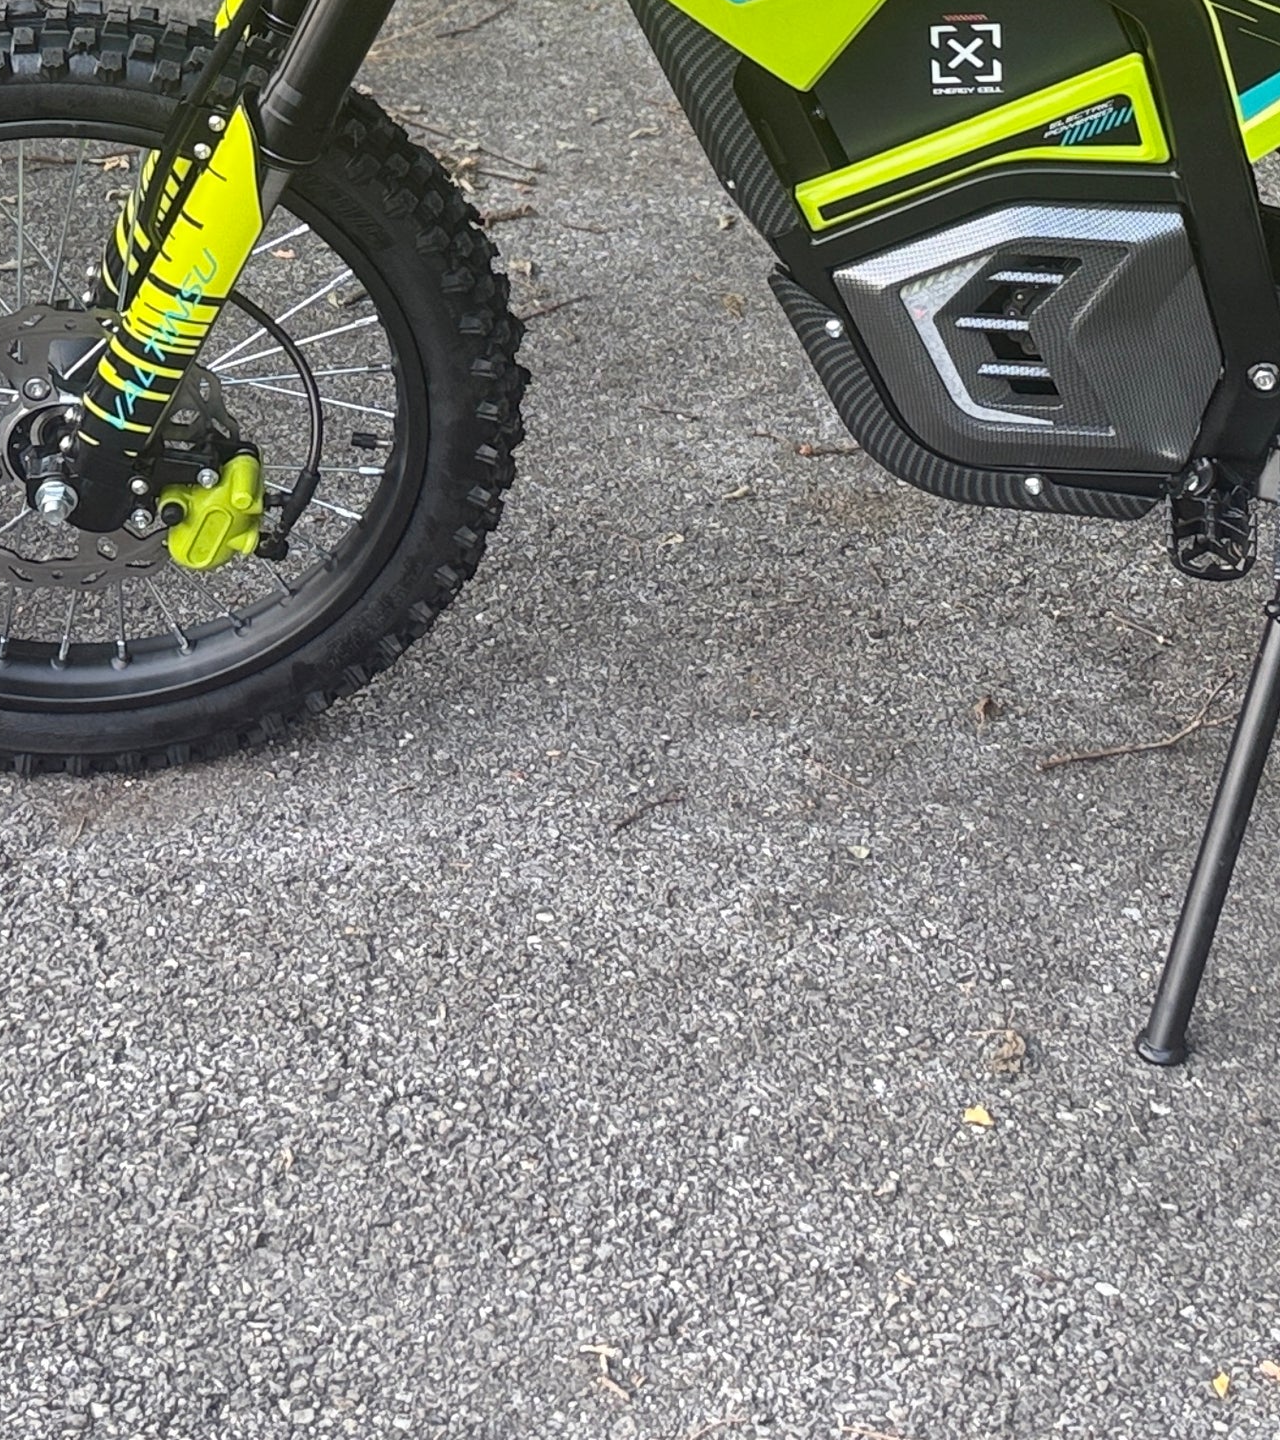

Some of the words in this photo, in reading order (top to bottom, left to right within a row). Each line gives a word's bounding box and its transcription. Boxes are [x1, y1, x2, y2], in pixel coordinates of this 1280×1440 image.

[931, 86, 976, 96] ENERGY
[976, 85, 1005, 95] CELL
[1043, 107, 1114, 139] POWERED
[1048, 98, 1116, 130] ELECTRIC
[104, 247, 219, 430] VALTINSU
